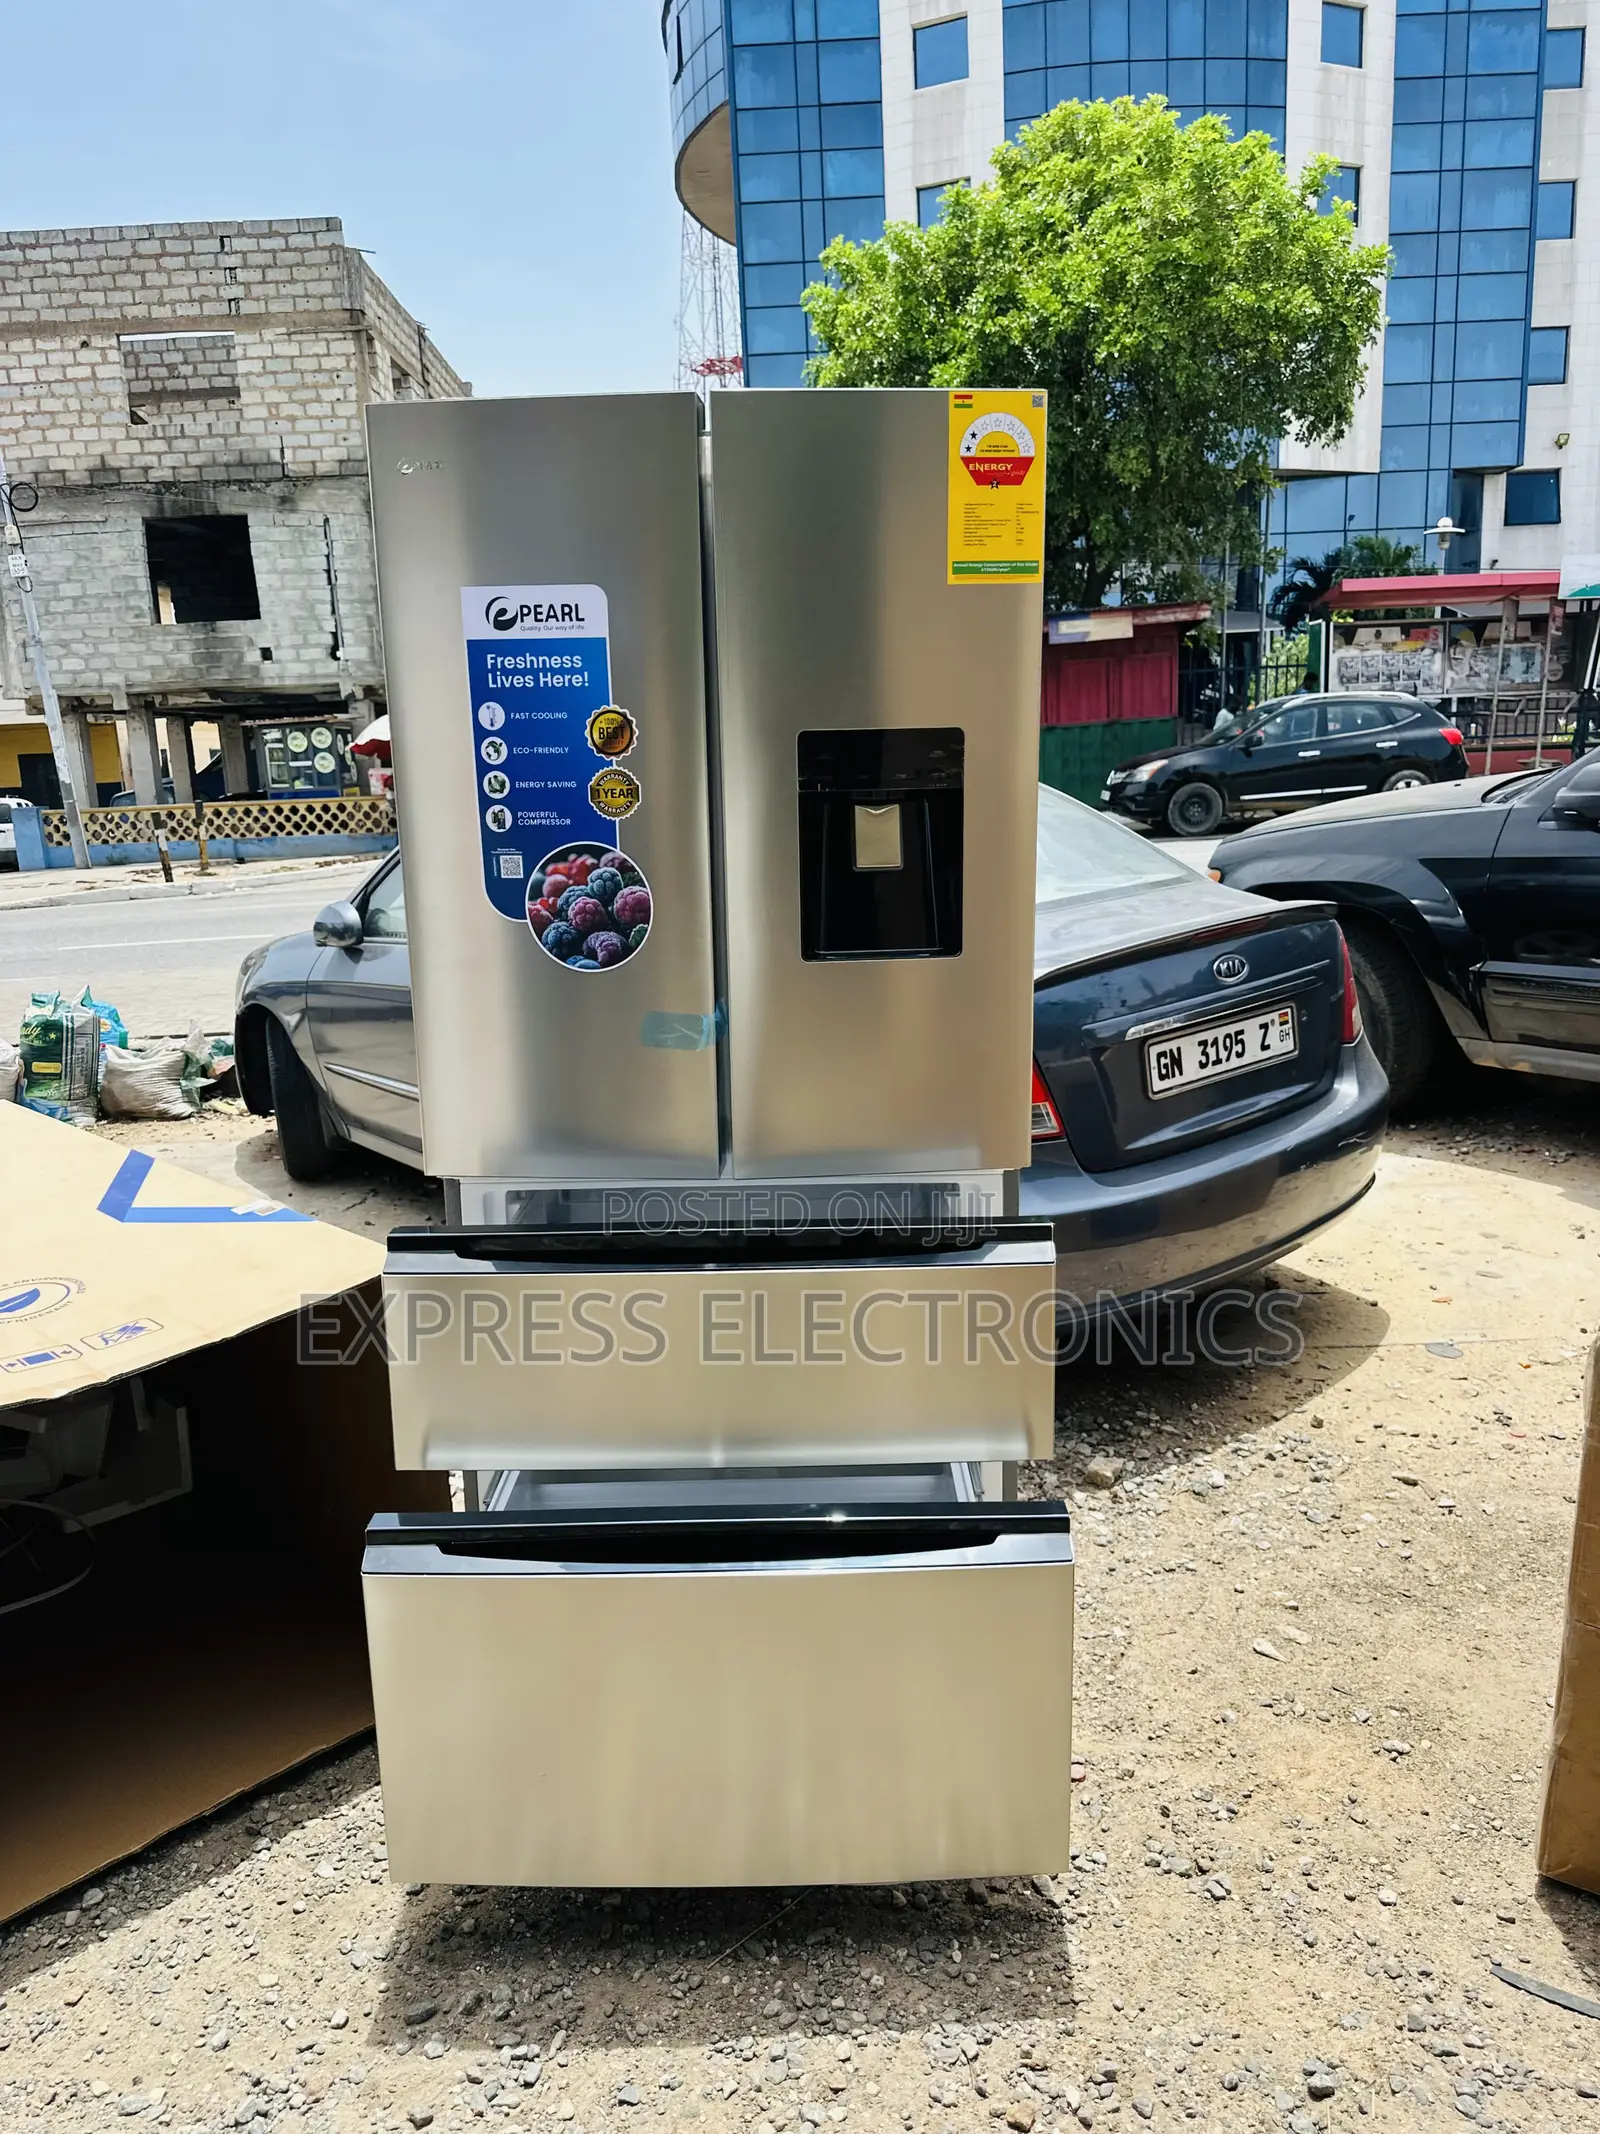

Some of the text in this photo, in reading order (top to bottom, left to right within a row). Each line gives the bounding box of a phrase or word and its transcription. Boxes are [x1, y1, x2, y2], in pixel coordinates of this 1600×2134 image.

[969, 462, 1013, 473] ENERGY
[519, 603, 585, 623] PEARL
[486, 652, 582, 669] Freshness
[488, 671, 589, 688] Lives Here!
[510, 712, 568, 720] FAST COOLING
[598, 726, 625, 741] BEST
[513, 746, 569, 754] ECO-FRIENDLY
[515, 780, 577, 789] ENERGY SAVING
[599, 773, 630, 786] WARRANTY
[599, 801, 631, 814] WARRANTY
[518, 818, 571, 826] COMPRESSOR
[1219, 959, 1243, 977] KIA
[1278, 1028, 1291, 1043] GH
[1156, 1021, 1271, 1082] GN 3195 Z
[0, 1300, 74, 1325] EFRIGERANT
